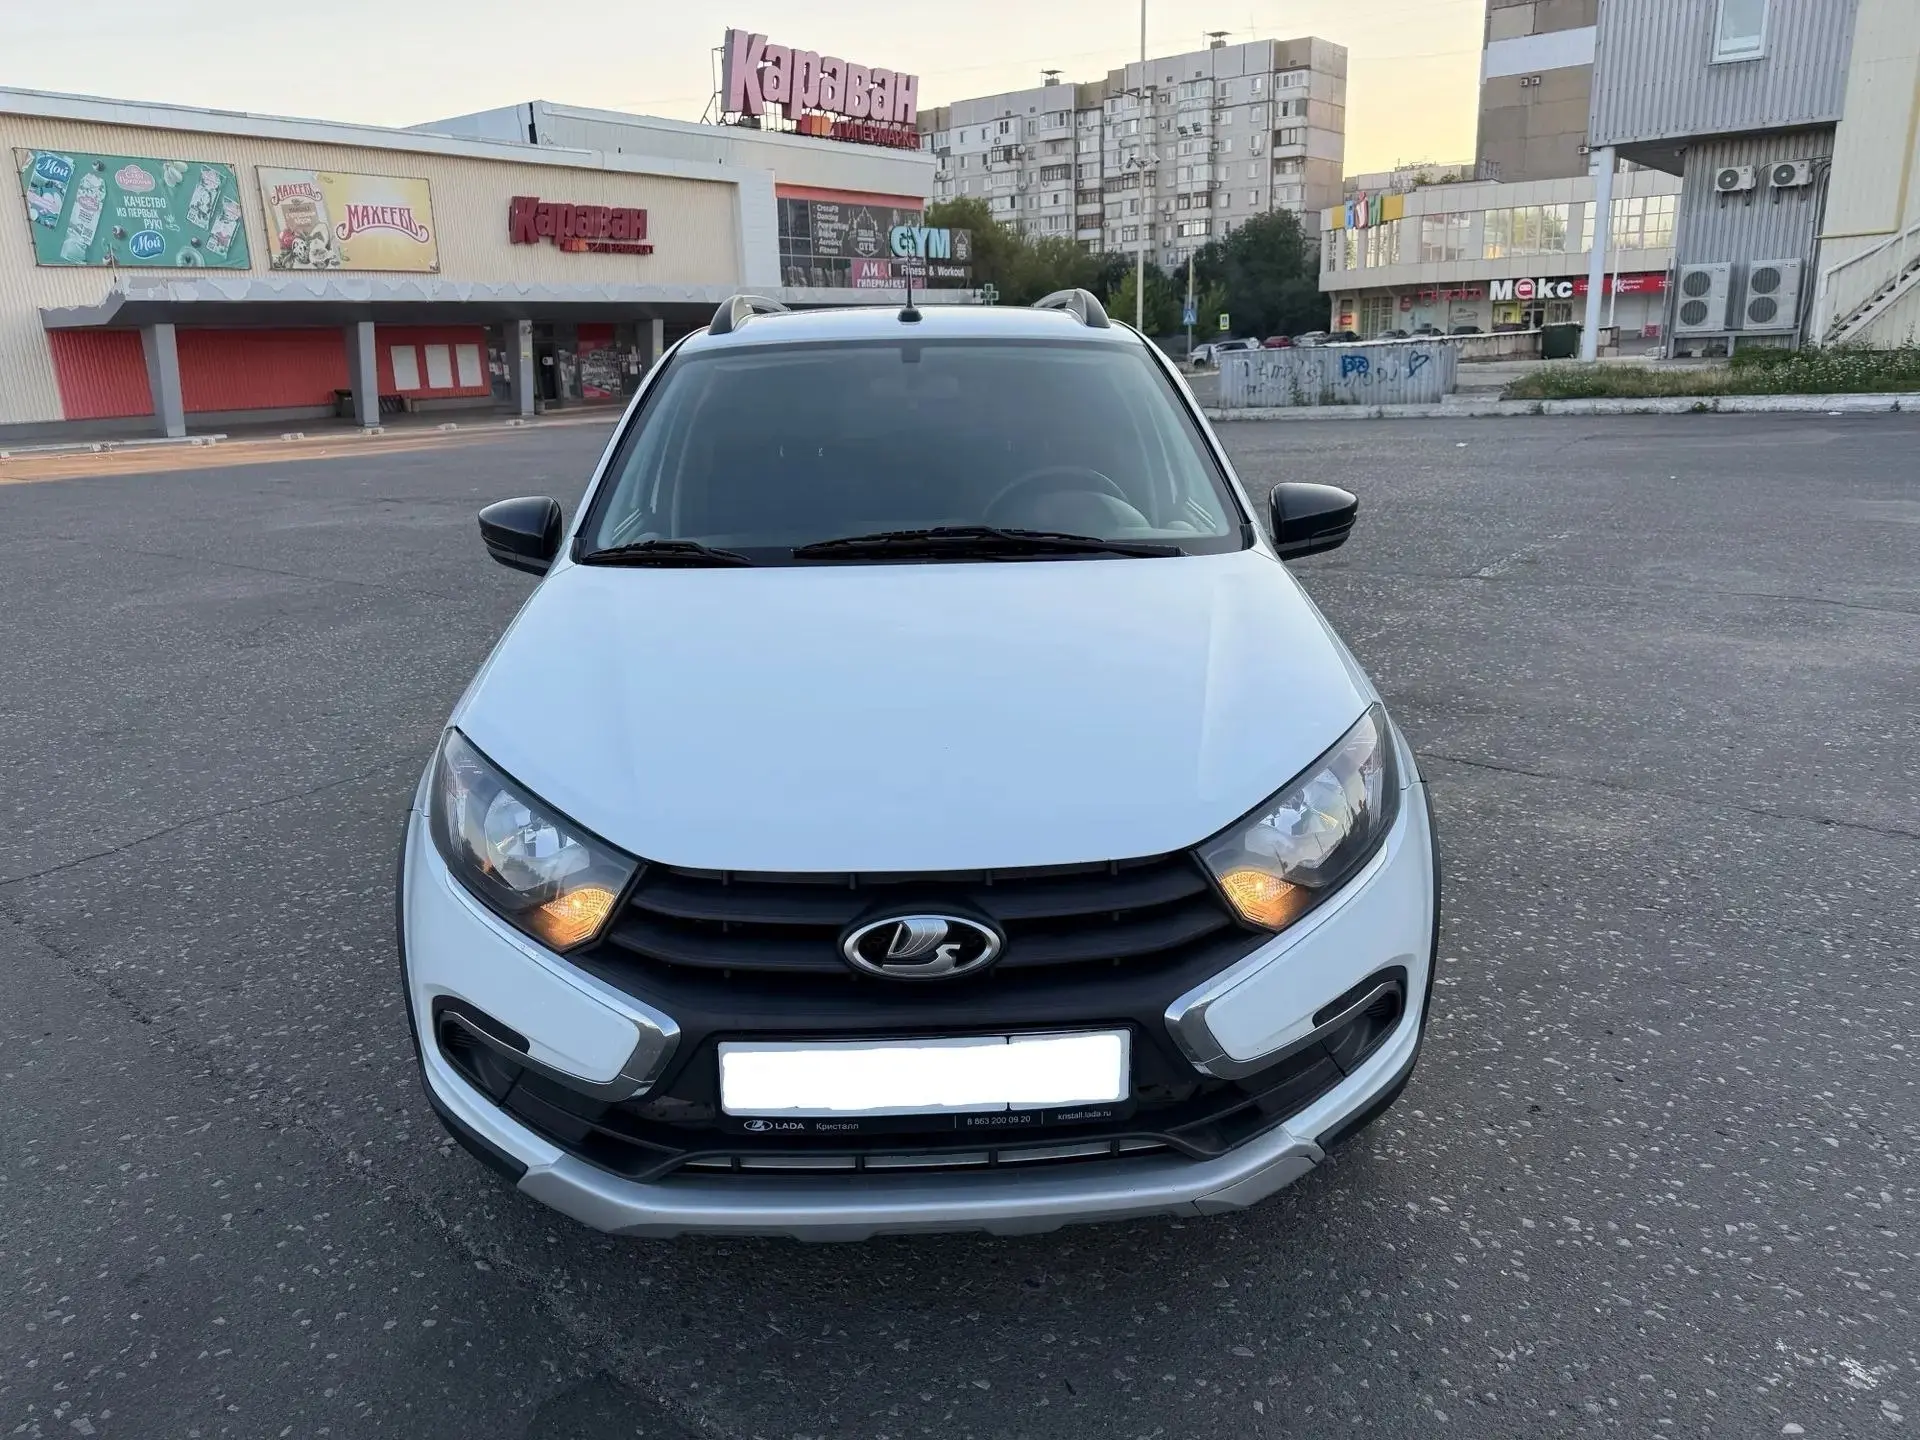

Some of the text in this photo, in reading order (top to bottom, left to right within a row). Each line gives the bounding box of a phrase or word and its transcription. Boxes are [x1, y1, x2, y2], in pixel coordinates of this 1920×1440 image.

[721, 28, 919, 124] Караван
[36, 159, 69, 178] Мой
[124, 195, 166, 208] КАЧЕСТВО
[116, 207, 159, 219] ИЗ ПЕРВЫХ
[509, 196, 647, 245] Караван
[132, 235, 161, 253] Мой
[890, 225, 951, 259] GYM
[929, 266, 935, 276] &
[937, 265, 965, 277] Workout
[775, 1122, 805, 1130] LADA
[992, 1116, 1006, 1125] 200
[1009, 1115, 1018, 1123] 09
[1021, 1115, 1031, 1123] 20
[816, 1122, 859, 1132] Кристалл
